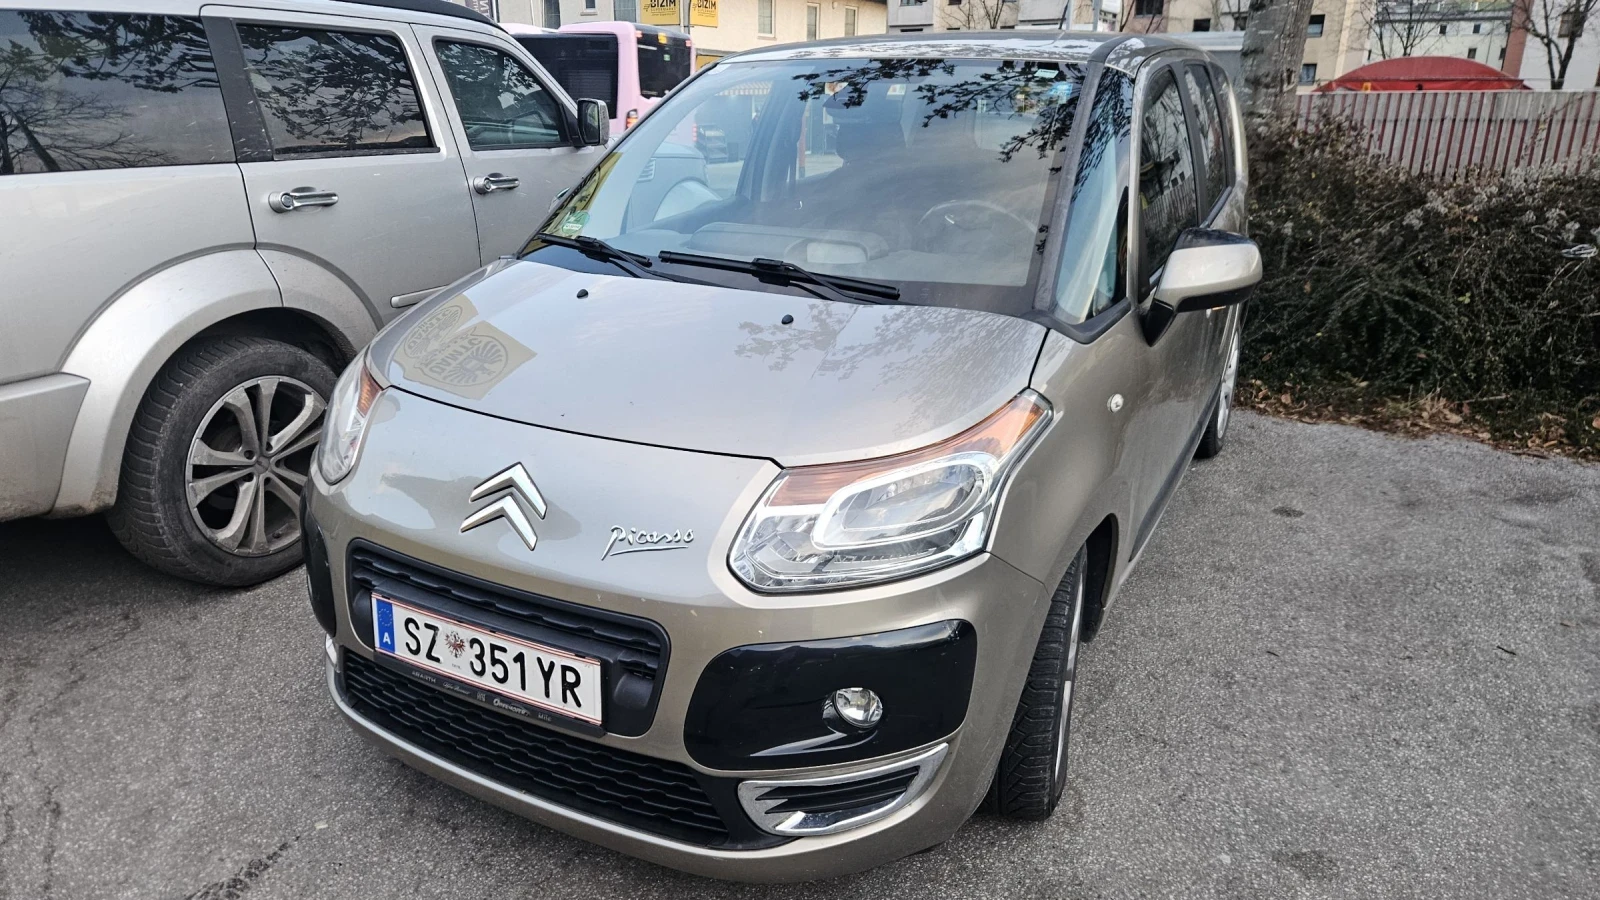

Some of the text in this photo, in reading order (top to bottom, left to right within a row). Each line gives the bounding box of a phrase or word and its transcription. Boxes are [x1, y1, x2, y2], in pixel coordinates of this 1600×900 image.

[601, 525, 694, 561] Picasso
[382, 632, 391, 645] A
[404, 617, 442, 664] SZ
